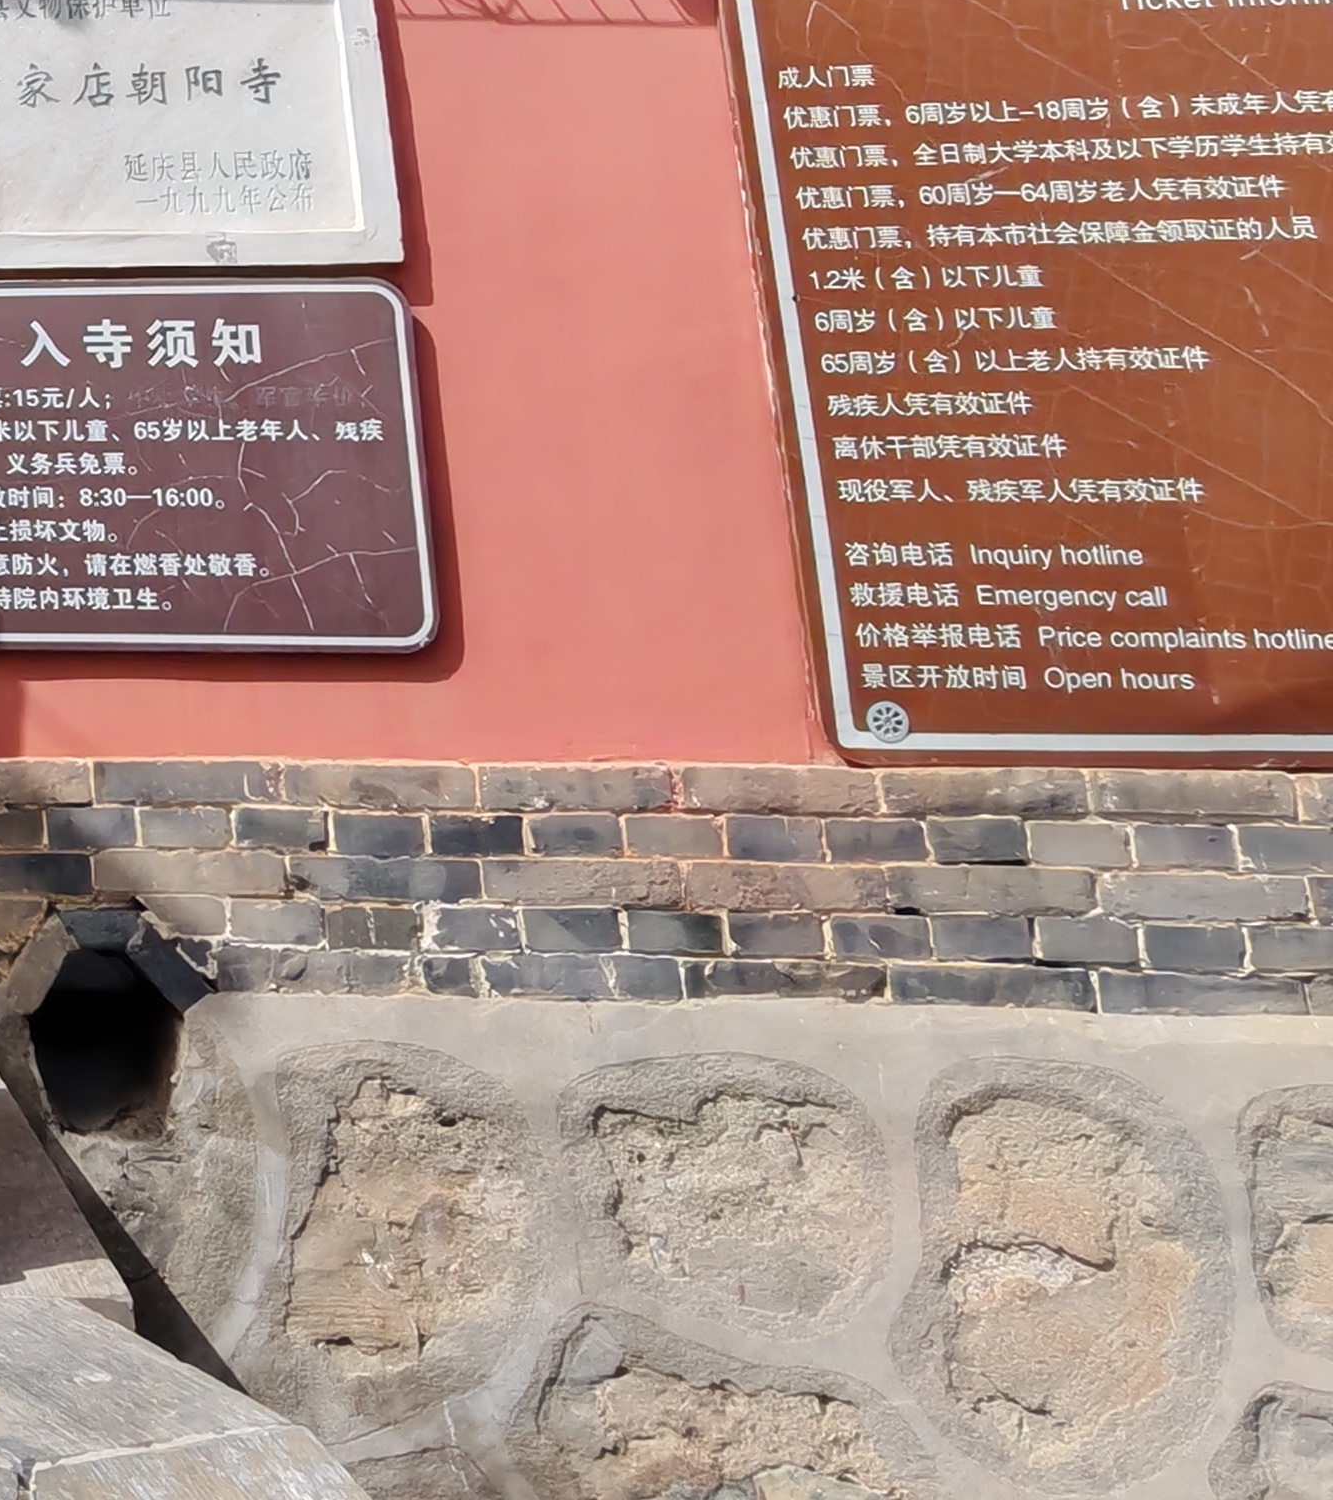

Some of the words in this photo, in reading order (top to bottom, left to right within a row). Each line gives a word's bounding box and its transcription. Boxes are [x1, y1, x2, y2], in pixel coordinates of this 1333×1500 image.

[777, 63, 876, 91] 成人门票
[789, 130, 1333, 170] 优惠门票，全日制大学本科及以下学历学生持有
[124, 147, 313, 184] 延庆县人民政府
[135, 183, 315, 216] 一九九九年公布
[20, 318, 264, 368] 入寺须知
[827, 391, 1034, 418] 残疾人凭有效证件
[833, 435, 1068, 462] 离休干部凭有效证件
[837, 477, 1205, 505] 现役军人、残疾军人凭有效证件
[843, 542, 955, 568] 咨询电话
[969, 544, 1053, 570] Inquiry
[1060, 543, 1144, 567] hotline
[850, 583, 960, 609] 救援电话
[975, 584, 1116, 611] Emergency
[1124, 585, 1168, 608] call
[855, 623, 1023, 650] 价格举报电话
[1037, 625, 1105, 649] Price
[1109, 626, 1247, 653] complaints
[860, 663, 1028, 691] 景区开放时间
[1043, 666, 1112, 694] Open
[1120, 666, 1196, 691] hours
